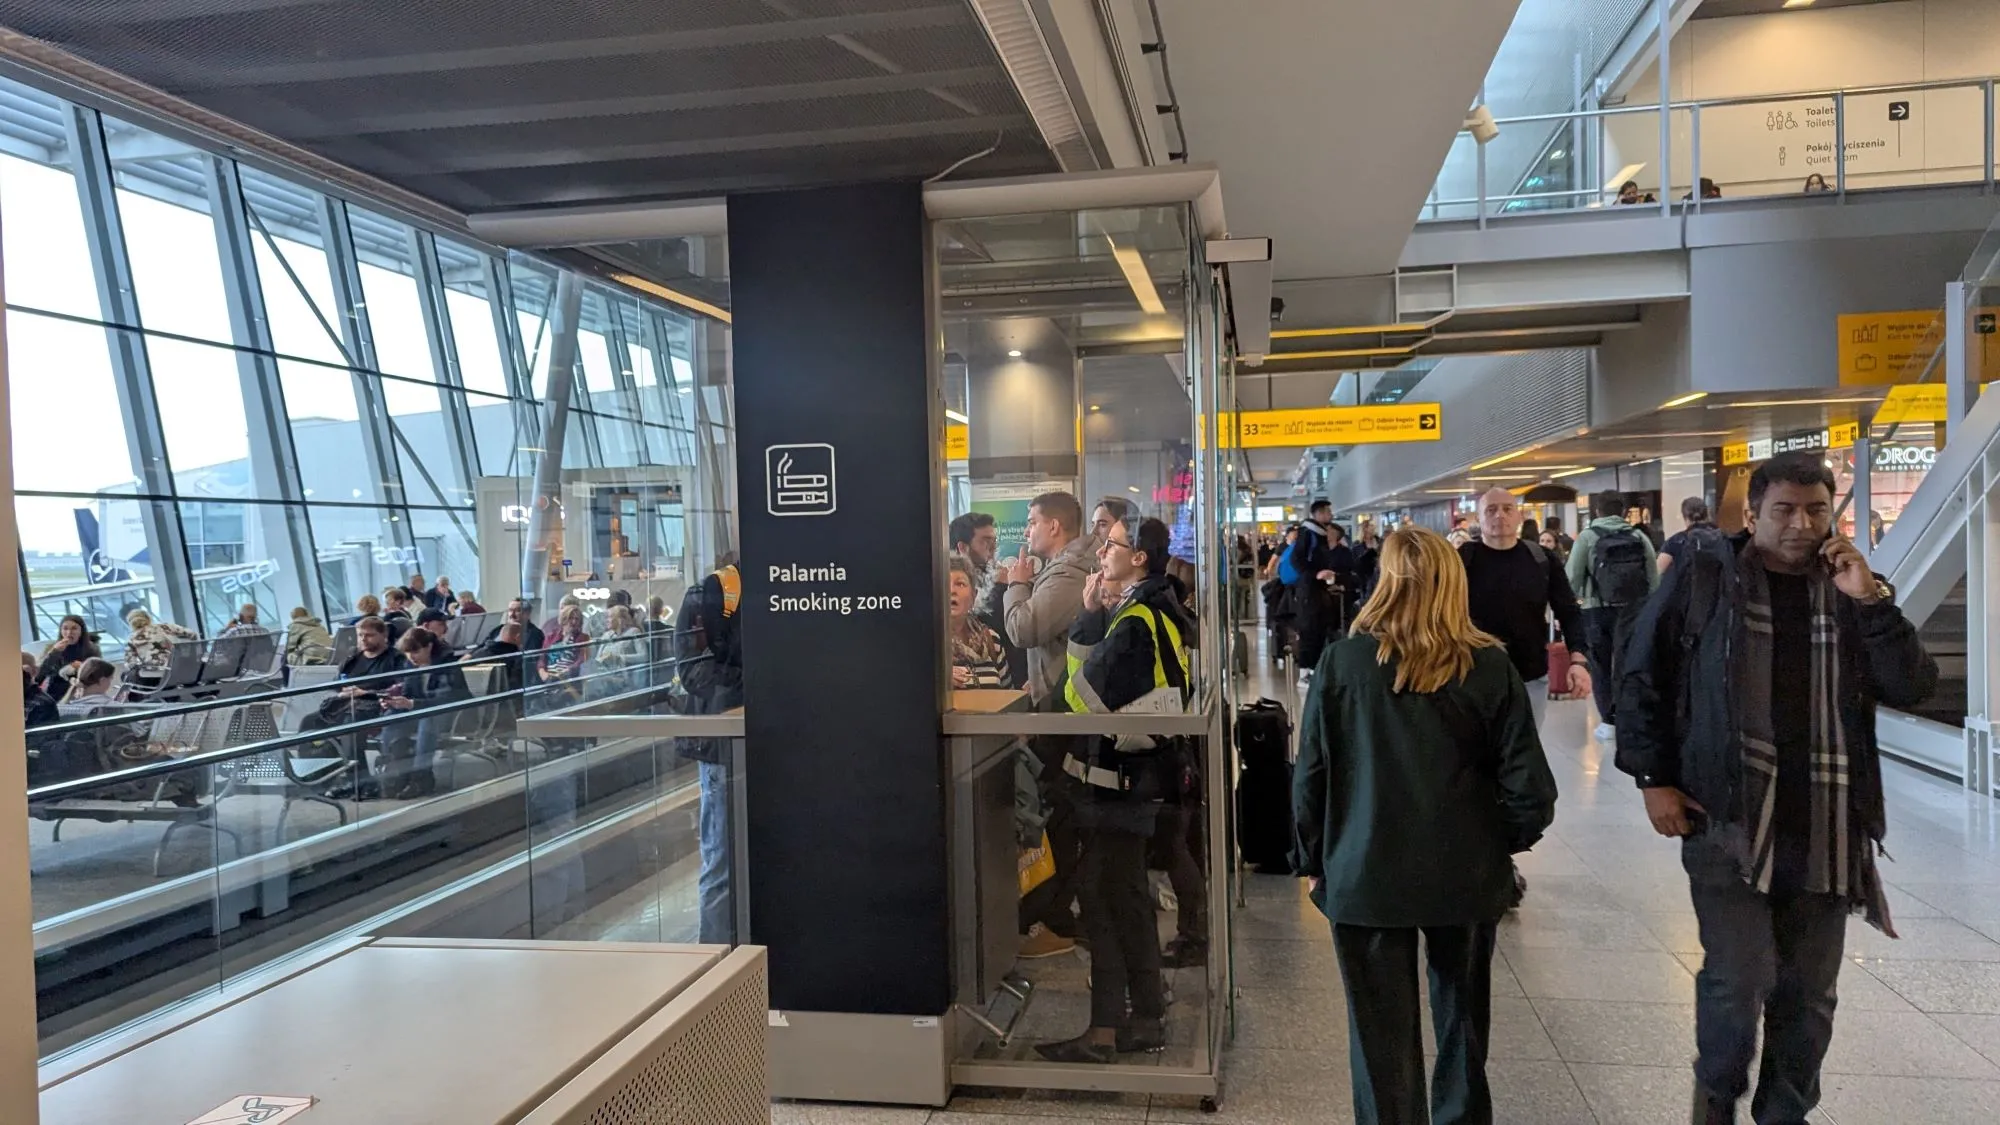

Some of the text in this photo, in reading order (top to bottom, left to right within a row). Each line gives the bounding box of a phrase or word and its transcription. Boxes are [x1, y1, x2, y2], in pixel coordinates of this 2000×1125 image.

[1806, 106, 1836, 115] Toalet
[1806, 119, 1836, 128] Toilets
[1806, 138, 1886, 152] Pokój yciszenia
[1806, 155, 1831, 165] Quiet
[1244, 423, 1259, 436] 33
[501, 505, 565, 524] IQ
[769, 562, 847, 582] Palarnia
[769, 592, 902, 615] Smoking zone
